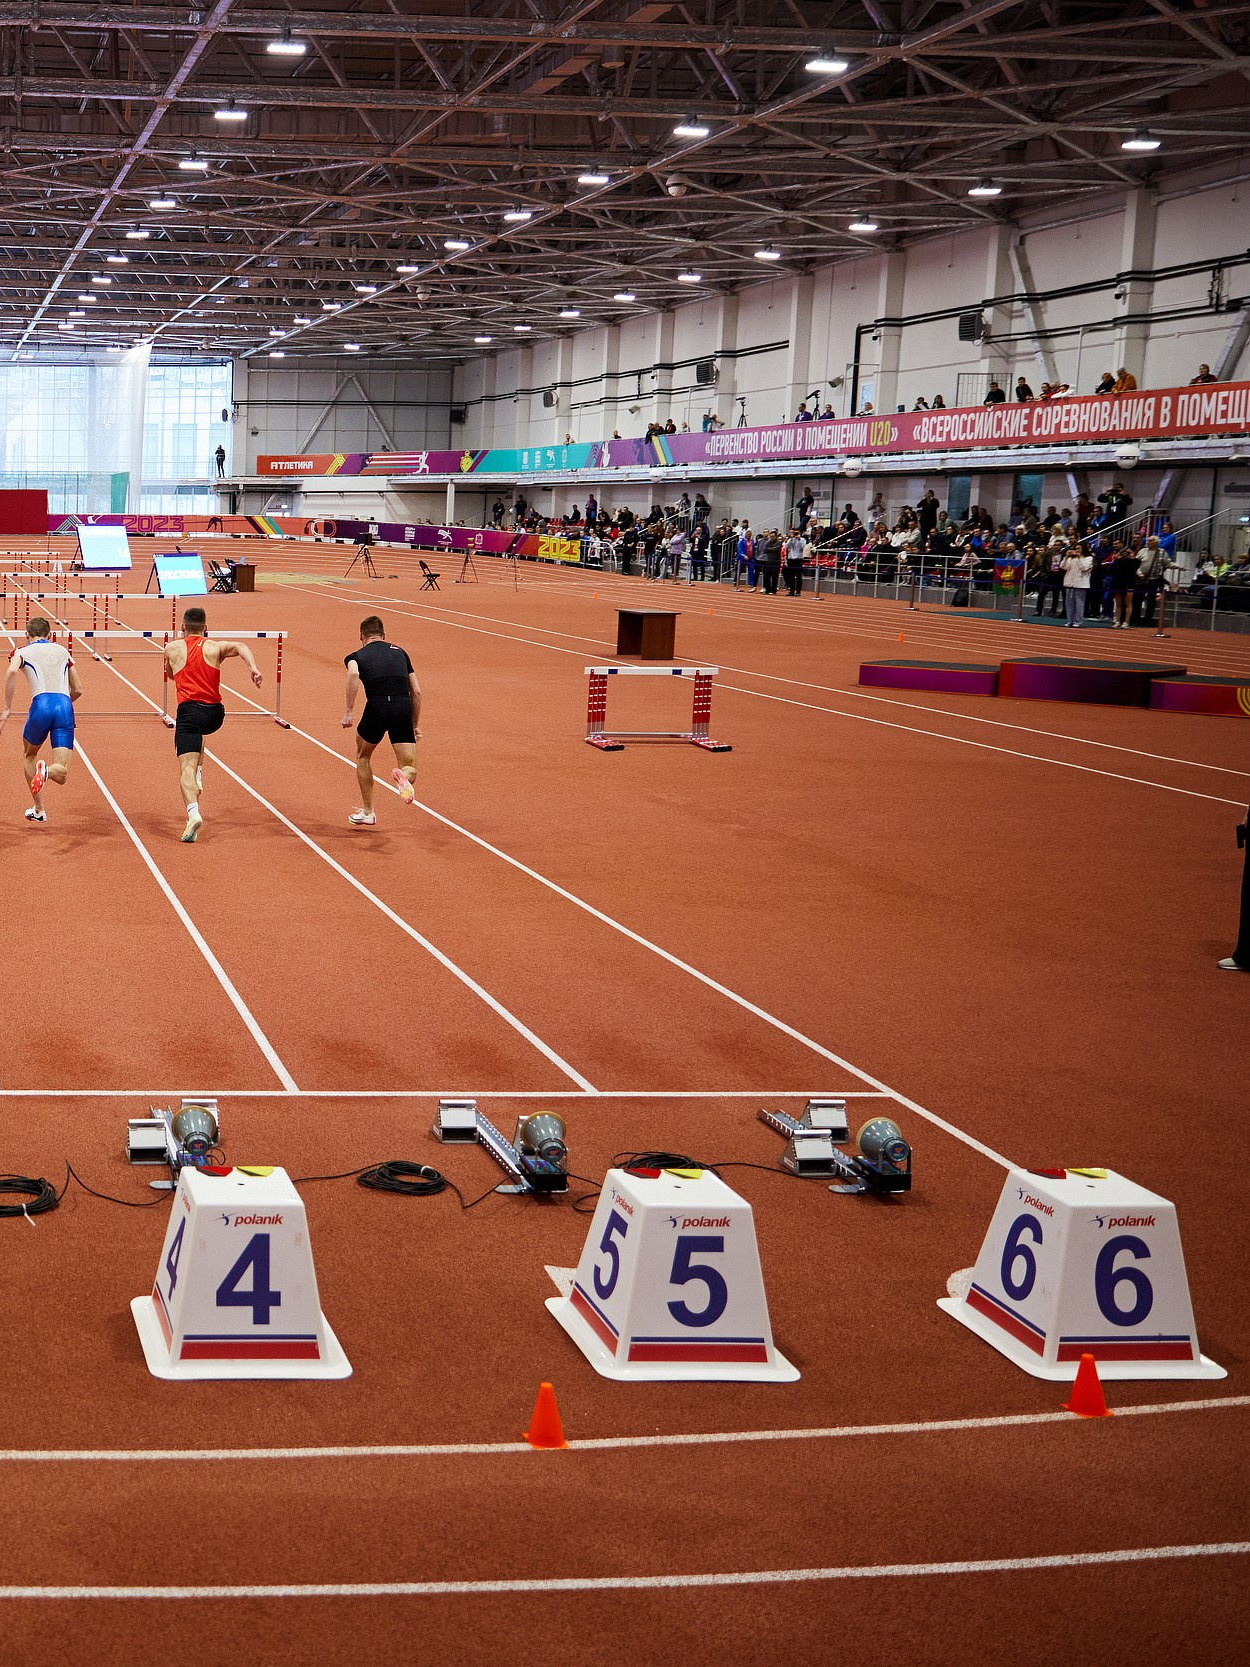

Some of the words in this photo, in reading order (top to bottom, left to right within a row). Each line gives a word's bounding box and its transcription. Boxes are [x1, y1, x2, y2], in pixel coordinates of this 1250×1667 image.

[912, 405, 1030, 443] «ВСЕРОССИЙСКИЕ
[1032, 397, 1156, 437] СОРЕВНОВАНИЯ
[1159, 396, 1172, 428] В
[705, 434, 759, 456] «ПЕРВЕНСТВО
[760, 428, 795, 453] РОССИИ
[796, 427, 803, 451] В
[804, 422, 868, 453] ПОМЕЩЕНИИ
[270, 460, 313, 470] АТЛЕТИКА
[123, 515, 184, 533] 2023
[538, 535, 581, 562] 2023
[234, 1213, 284, 1227] polanik
[614, 1193, 634, 1218] polanik
[1023, 1194, 1055, 1218] polanik
[681, 1216, 731, 1230] polanik
[1107, 1214, 1156, 1229] polanik
[166, 1215, 187, 1302] 4
[593, 1208, 629, 1300] 5
[1000, 1213, 1043, 1302] 6
[216, 1233, 281, 1325] 4
[667, 1235, 728, 1328] 5
[1094, 1234, 1153, 1327] 6
